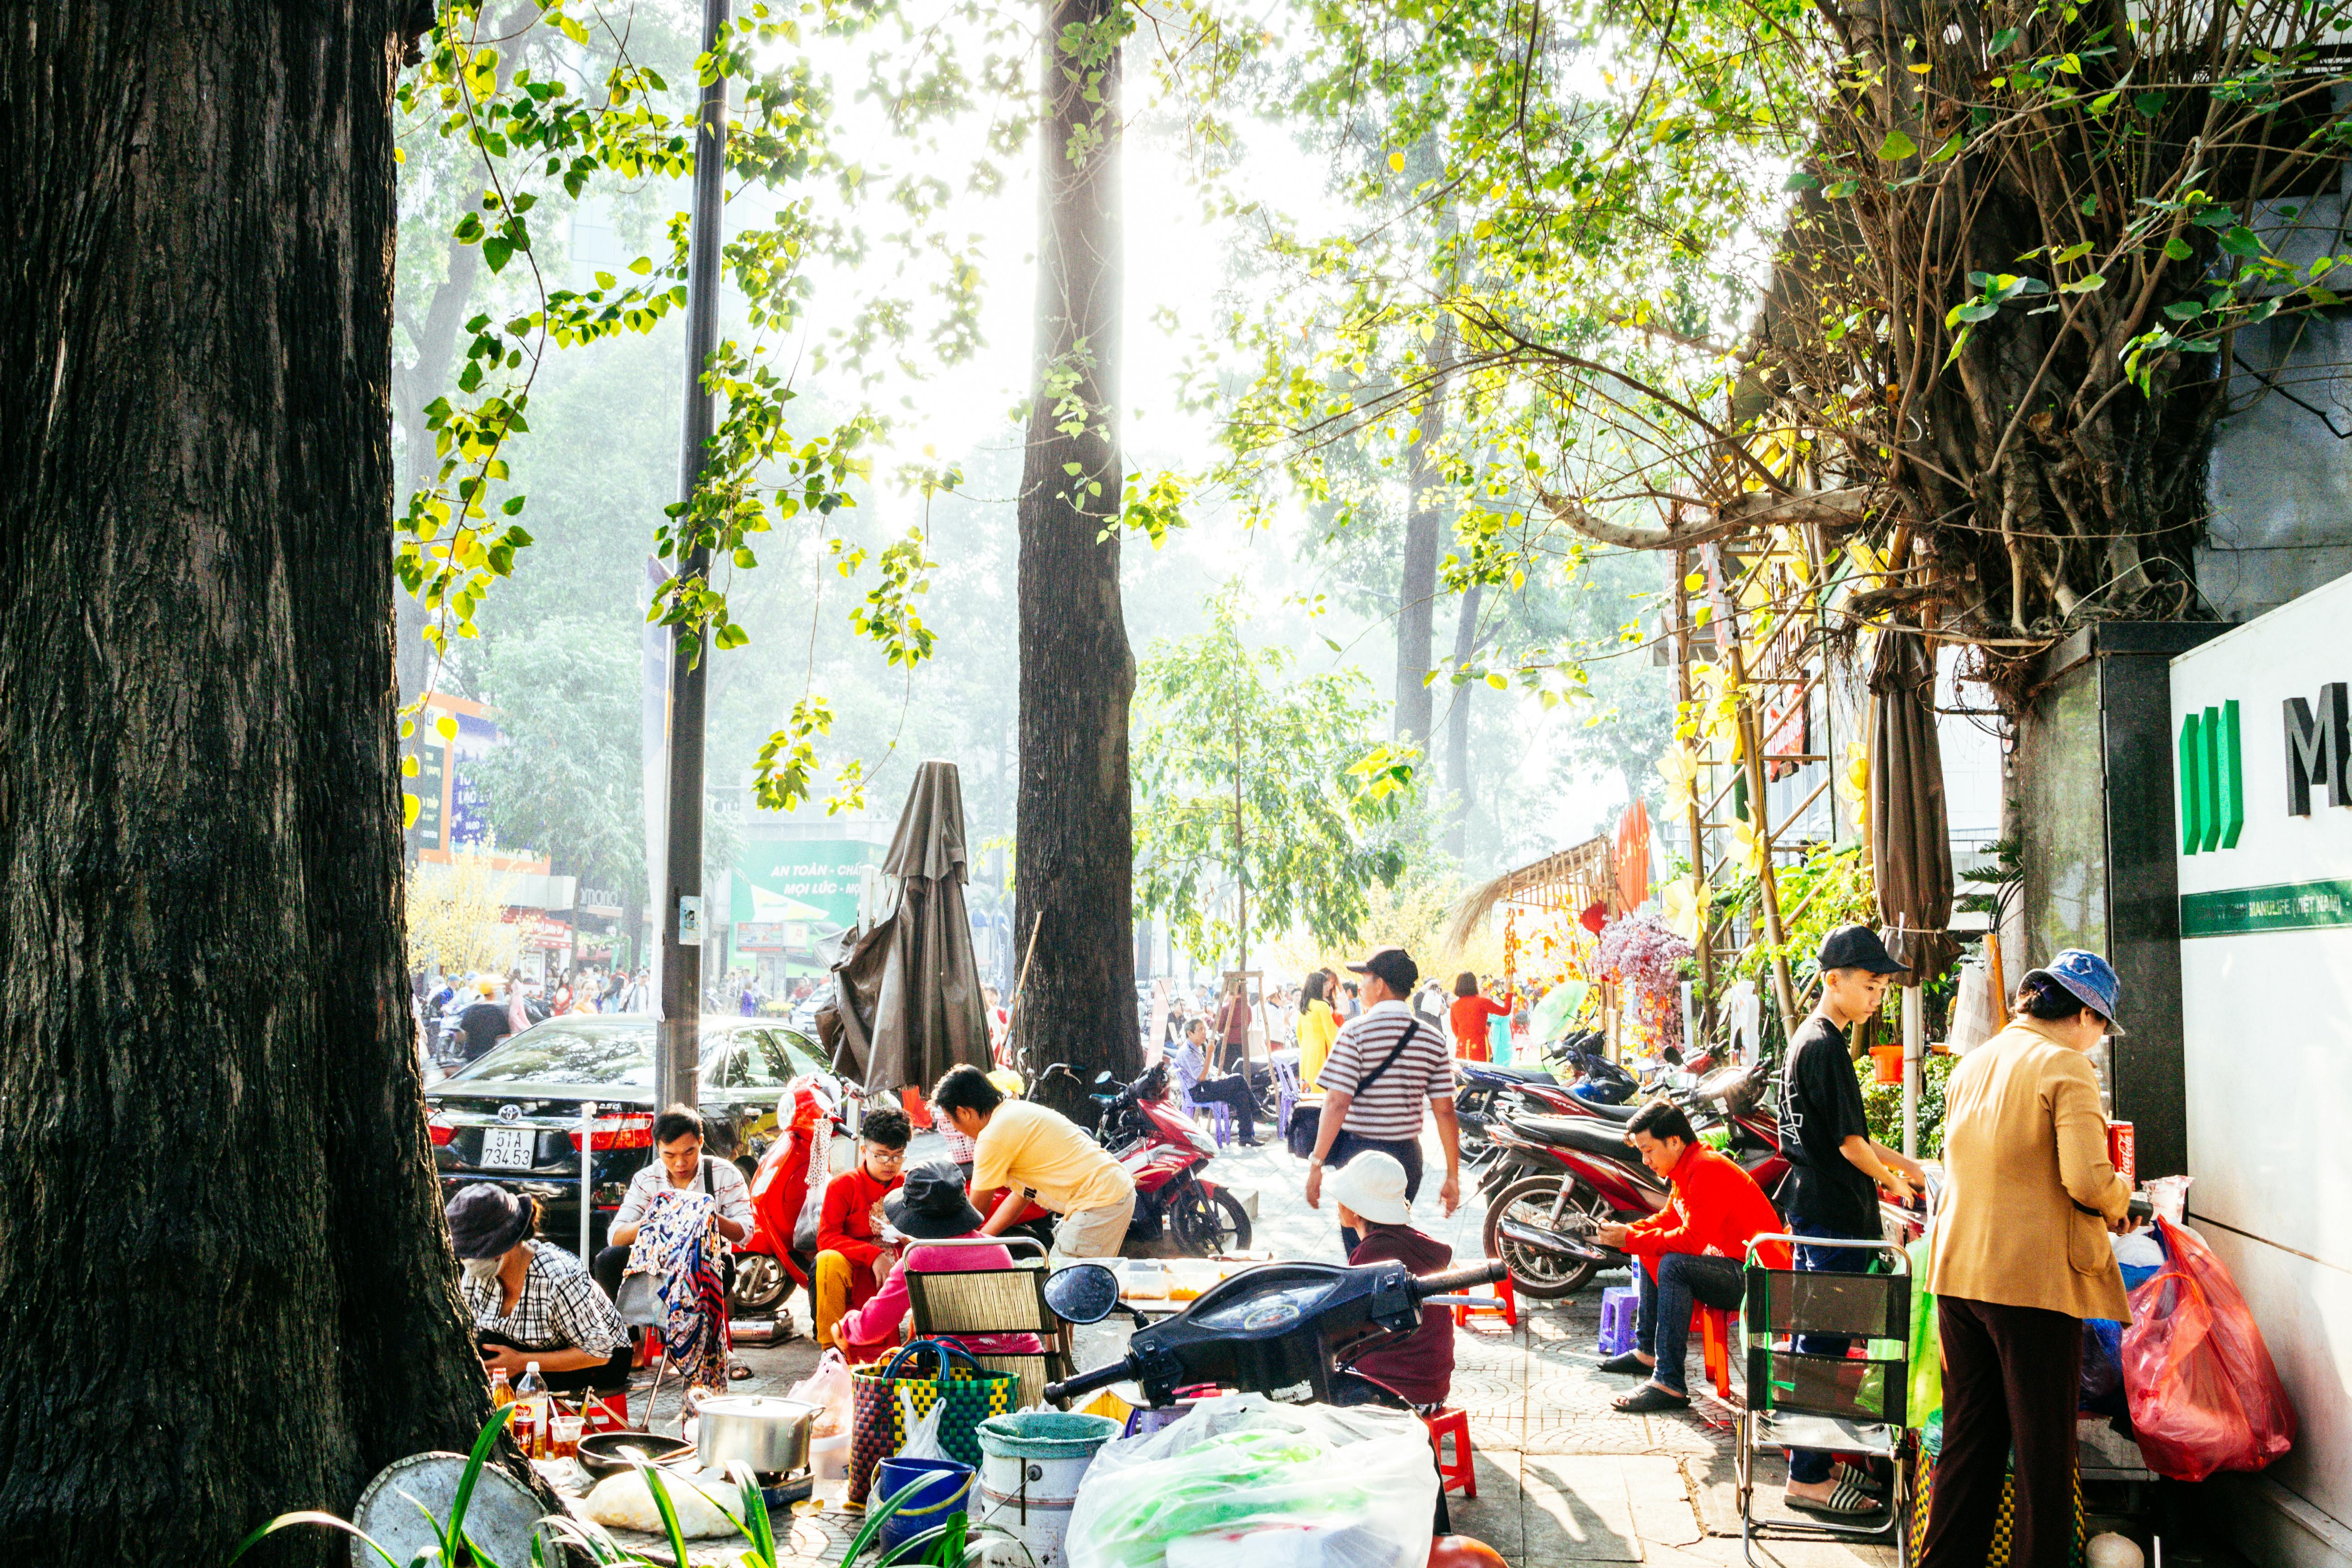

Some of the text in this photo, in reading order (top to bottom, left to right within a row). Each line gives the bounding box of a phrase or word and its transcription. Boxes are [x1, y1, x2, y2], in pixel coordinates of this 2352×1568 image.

[2283, 682, 2352, 817] M
[771, 866, 790, 877] AN
[793, 862, 828, 876] TOÀN
[784, 883, 810, 897] MỌI
[812, 880, 837, 894] LÚC
[2249, 899, 2290, 917] MANULIFE
[496, 1132, 521, 1148] 51A
[485, 1148, 530, 1166] 734.53
